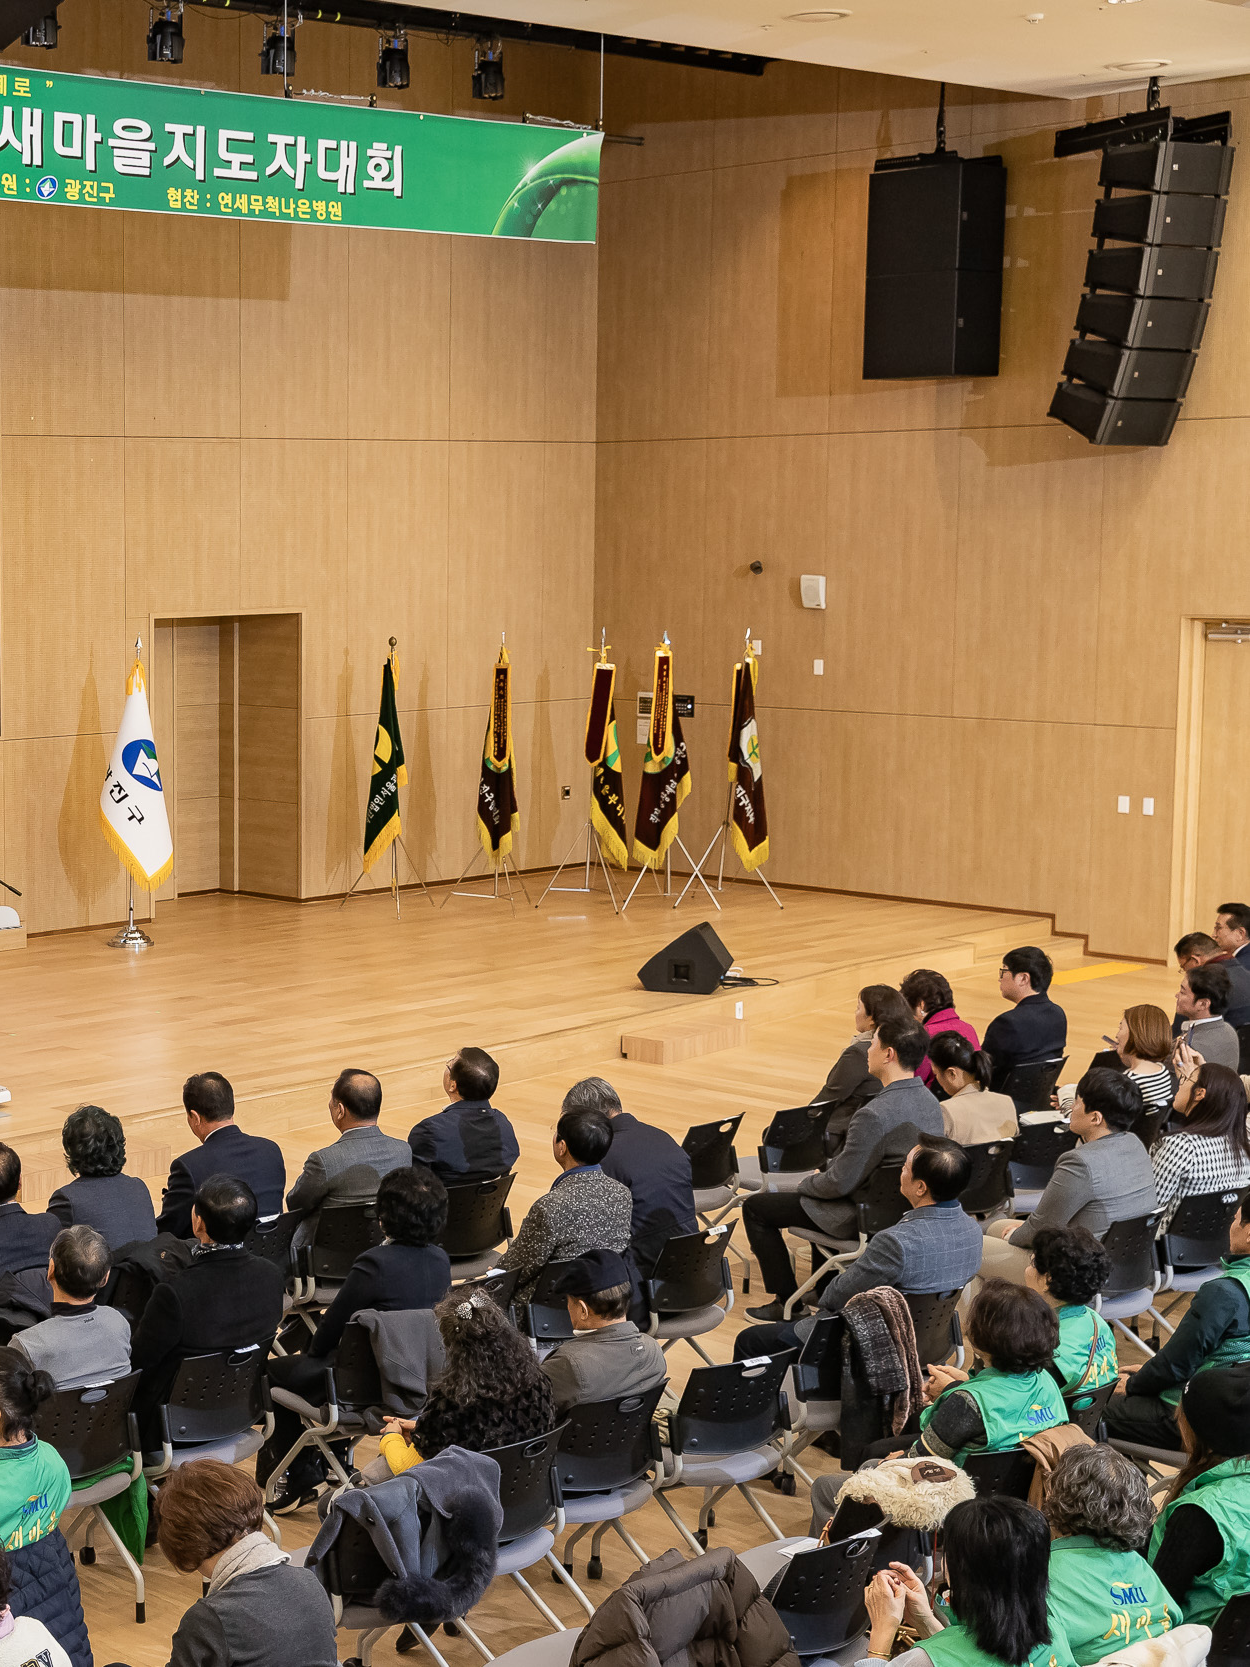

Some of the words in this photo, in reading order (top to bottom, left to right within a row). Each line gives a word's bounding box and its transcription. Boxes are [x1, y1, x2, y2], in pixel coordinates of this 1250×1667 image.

[63, 178, 117, 204] 광진구
[165, 186, 201, 211] 협찬
[217, 191, 343, 222] 연세무척나은병원
[1027, 1405, 1057, 1427] SMU
[1109, 1584, 1150, 1607] SMU
